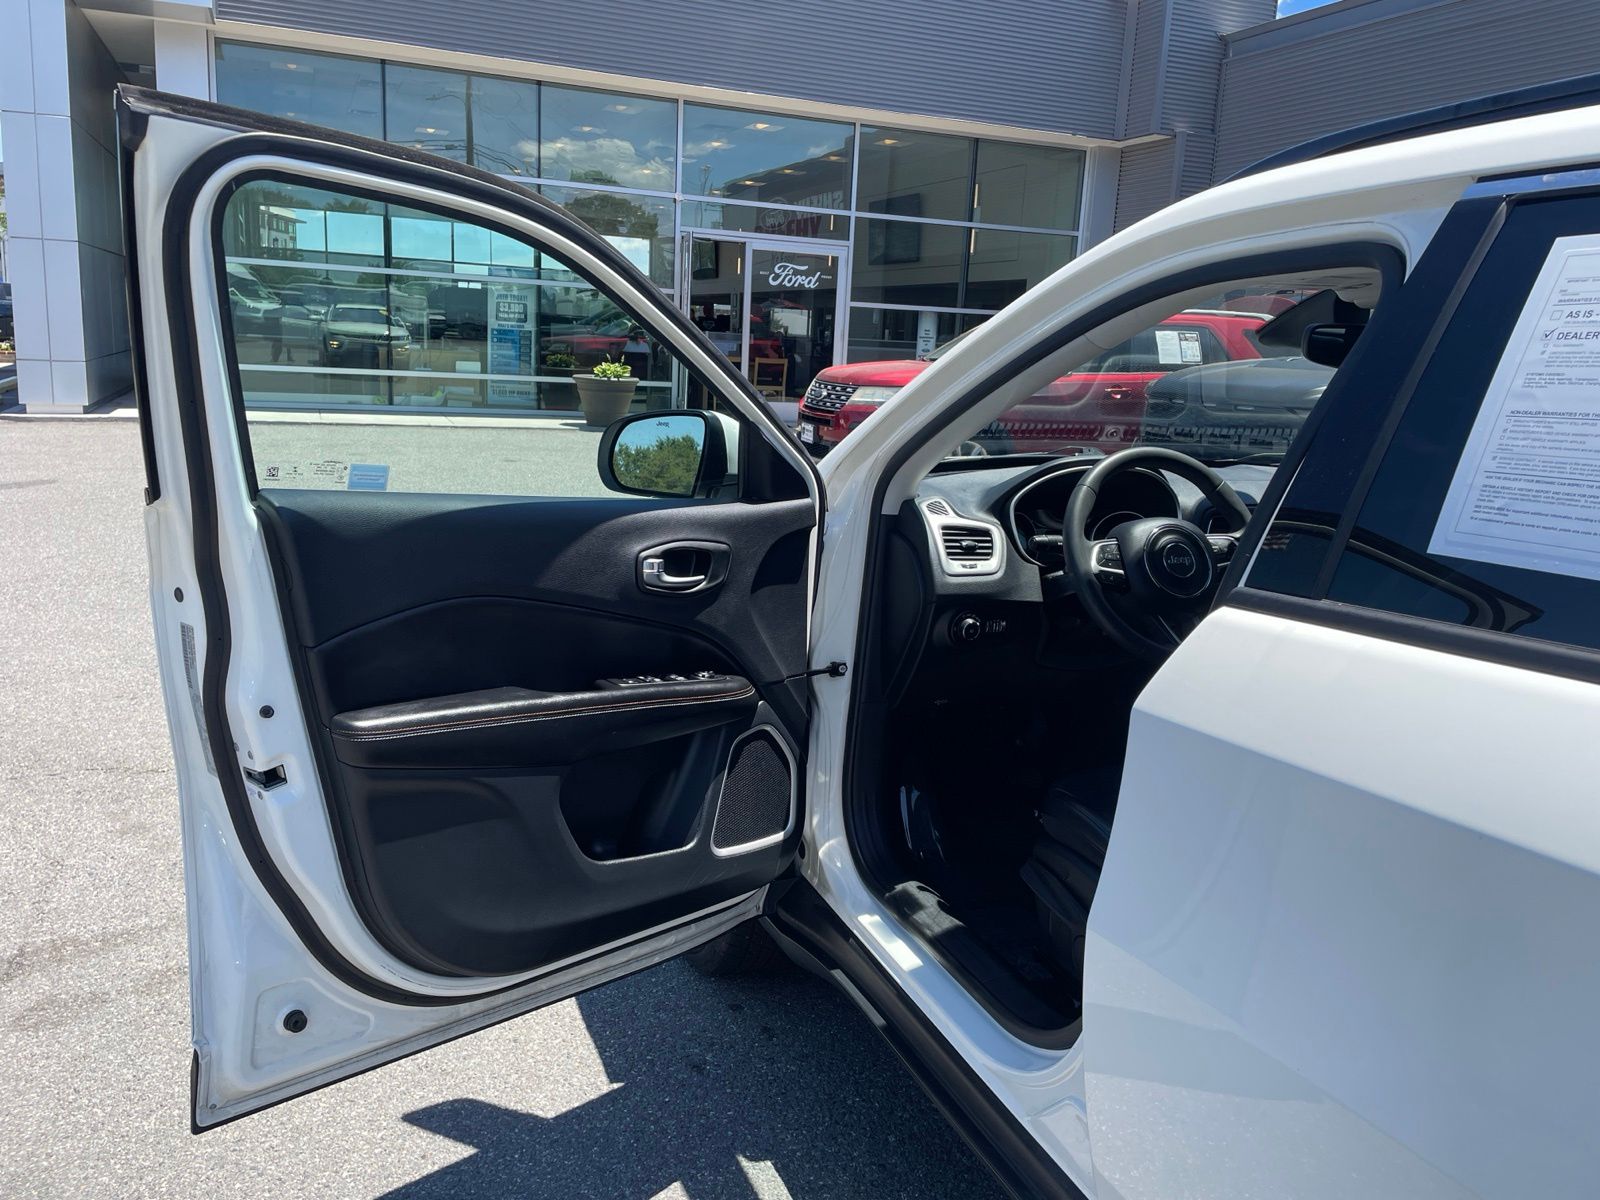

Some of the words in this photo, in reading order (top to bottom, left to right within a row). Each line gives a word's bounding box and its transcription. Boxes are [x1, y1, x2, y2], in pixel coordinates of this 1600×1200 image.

[769, 262, 820, 288] Ford
[1565, 310, 1581, 319] AS
[1583, 310, 1594, 318] IS
[1556, 331, 1600, 340] DEALER
[1168, 555, 1191, 566] Jeep
